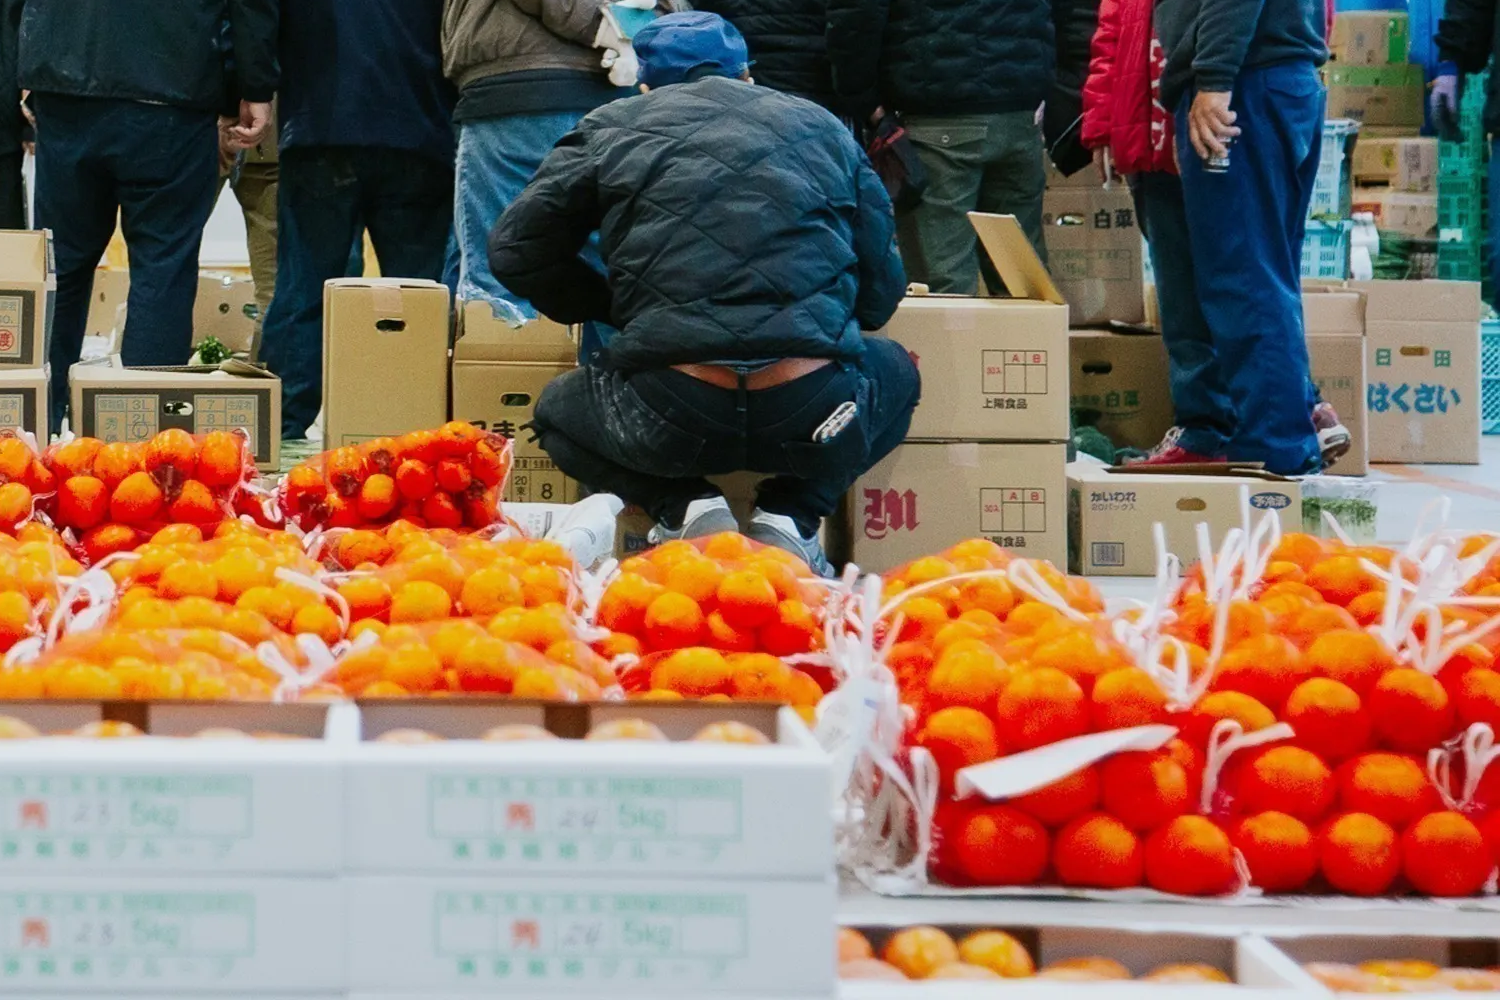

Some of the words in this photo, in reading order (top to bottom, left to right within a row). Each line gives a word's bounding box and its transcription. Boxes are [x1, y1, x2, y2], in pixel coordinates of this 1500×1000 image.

[1094, 209, 1134, 229] 白菜
[1012, 354, 1020, 363] A
[1367, 382, 1461, 413] はくさい
[132, 400, 150, 410] 3L
[982, 398, 1028, 409] 上陽食品
[132, 414, 148, 424] 2L
[541, 483, 553, 499] 8
[1009, 492, 1017, 500] A
[1091, 491, 1137, 502] かいわれ
